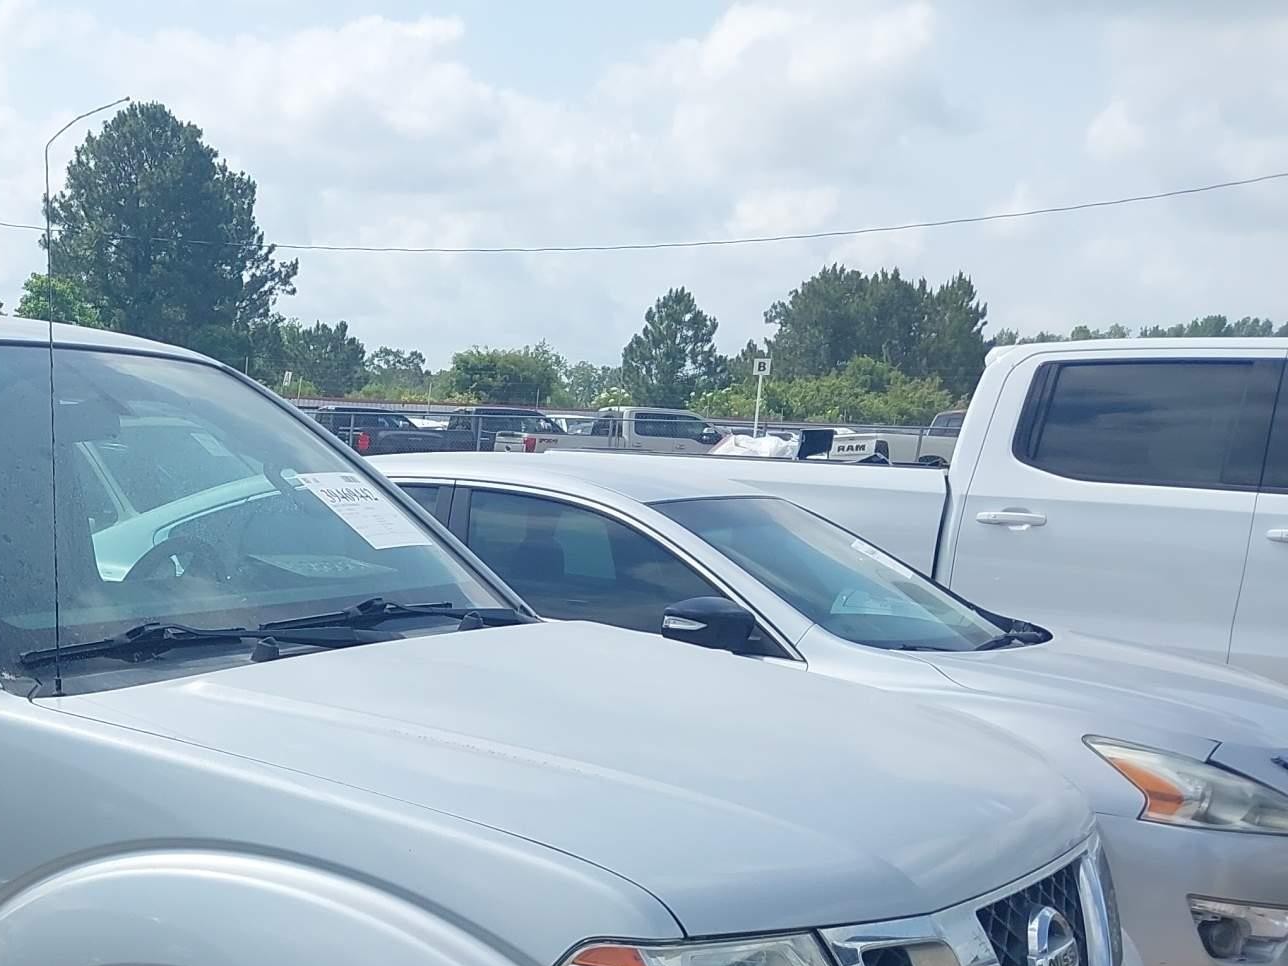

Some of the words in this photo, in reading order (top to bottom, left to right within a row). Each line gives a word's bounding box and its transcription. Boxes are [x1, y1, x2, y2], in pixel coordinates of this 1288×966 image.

[758, 361, 767, 372] B
[837, 443, 866, 453] RAM
[319, 488, 379, 504] 39469442
